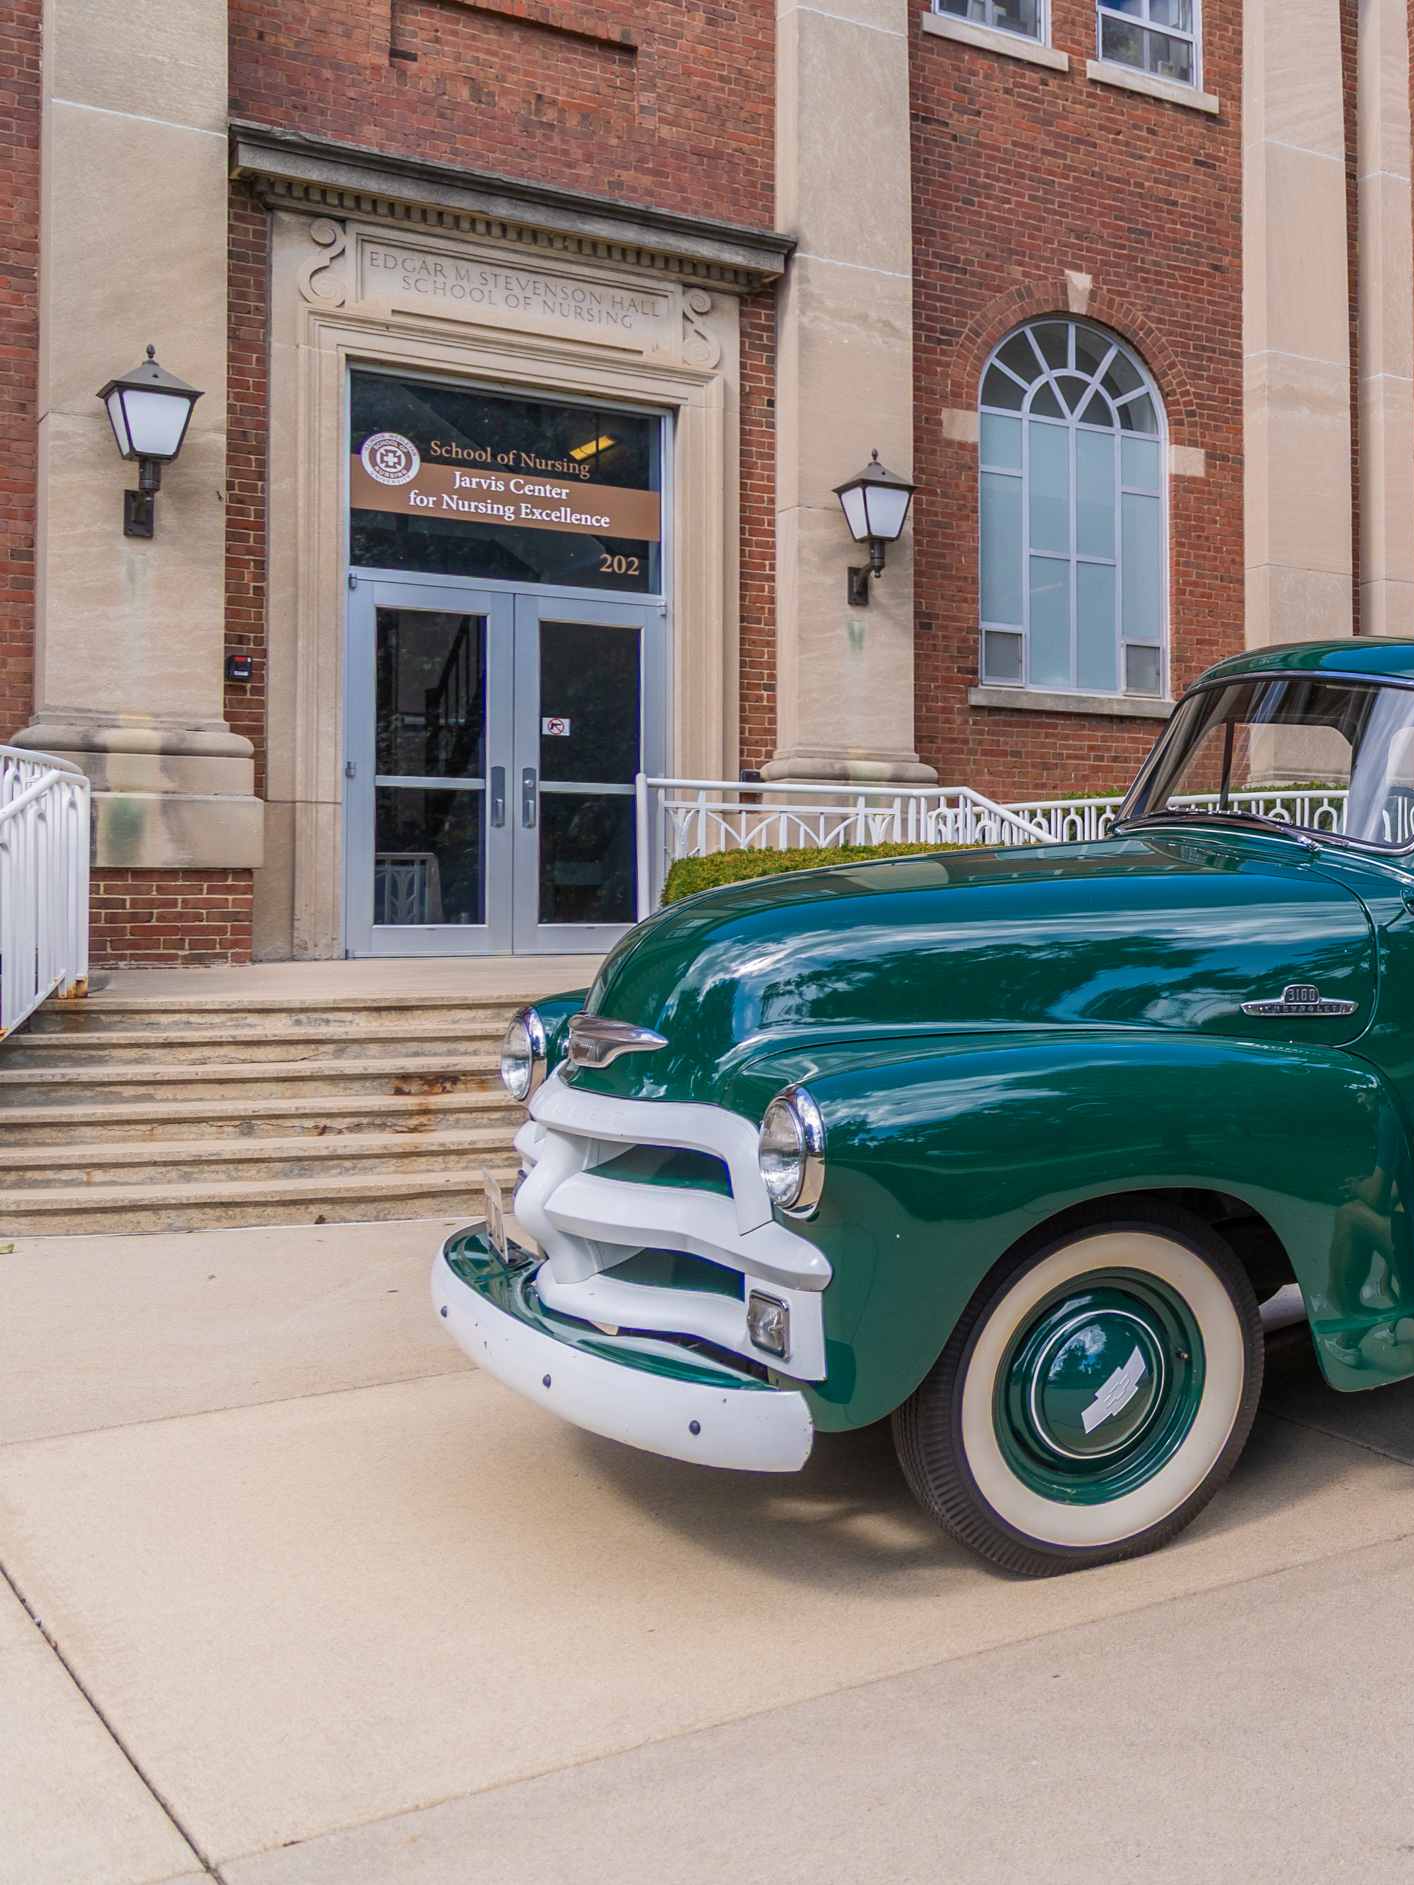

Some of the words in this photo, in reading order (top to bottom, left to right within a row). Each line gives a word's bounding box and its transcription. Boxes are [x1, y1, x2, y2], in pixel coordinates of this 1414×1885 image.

[370, 251, 447, 279] EDGAR
[480, 271, 601, 305] STEVENSON
[612, 295, 660, 317] HALL
[402, 275, 496, 306] SCHOOL
[505, 293, 532, 311] OF
[544, 300, 633, 329] NURSING
[430, 440, 491, 463] School
[497, 450, 517, 465] of
[520, 453, 591, 479] Nursing
[454, 471, 505, 492] Jarvis
[510, 478, 570, 500] Center
[409, 490, 437, 508] for
[442, 494, 515, 521] Nursing
[520, 503, 611, 528] Excellence
[600, 553, 640, 576] 202
[1287, 988, 1316, 1001] 3100
